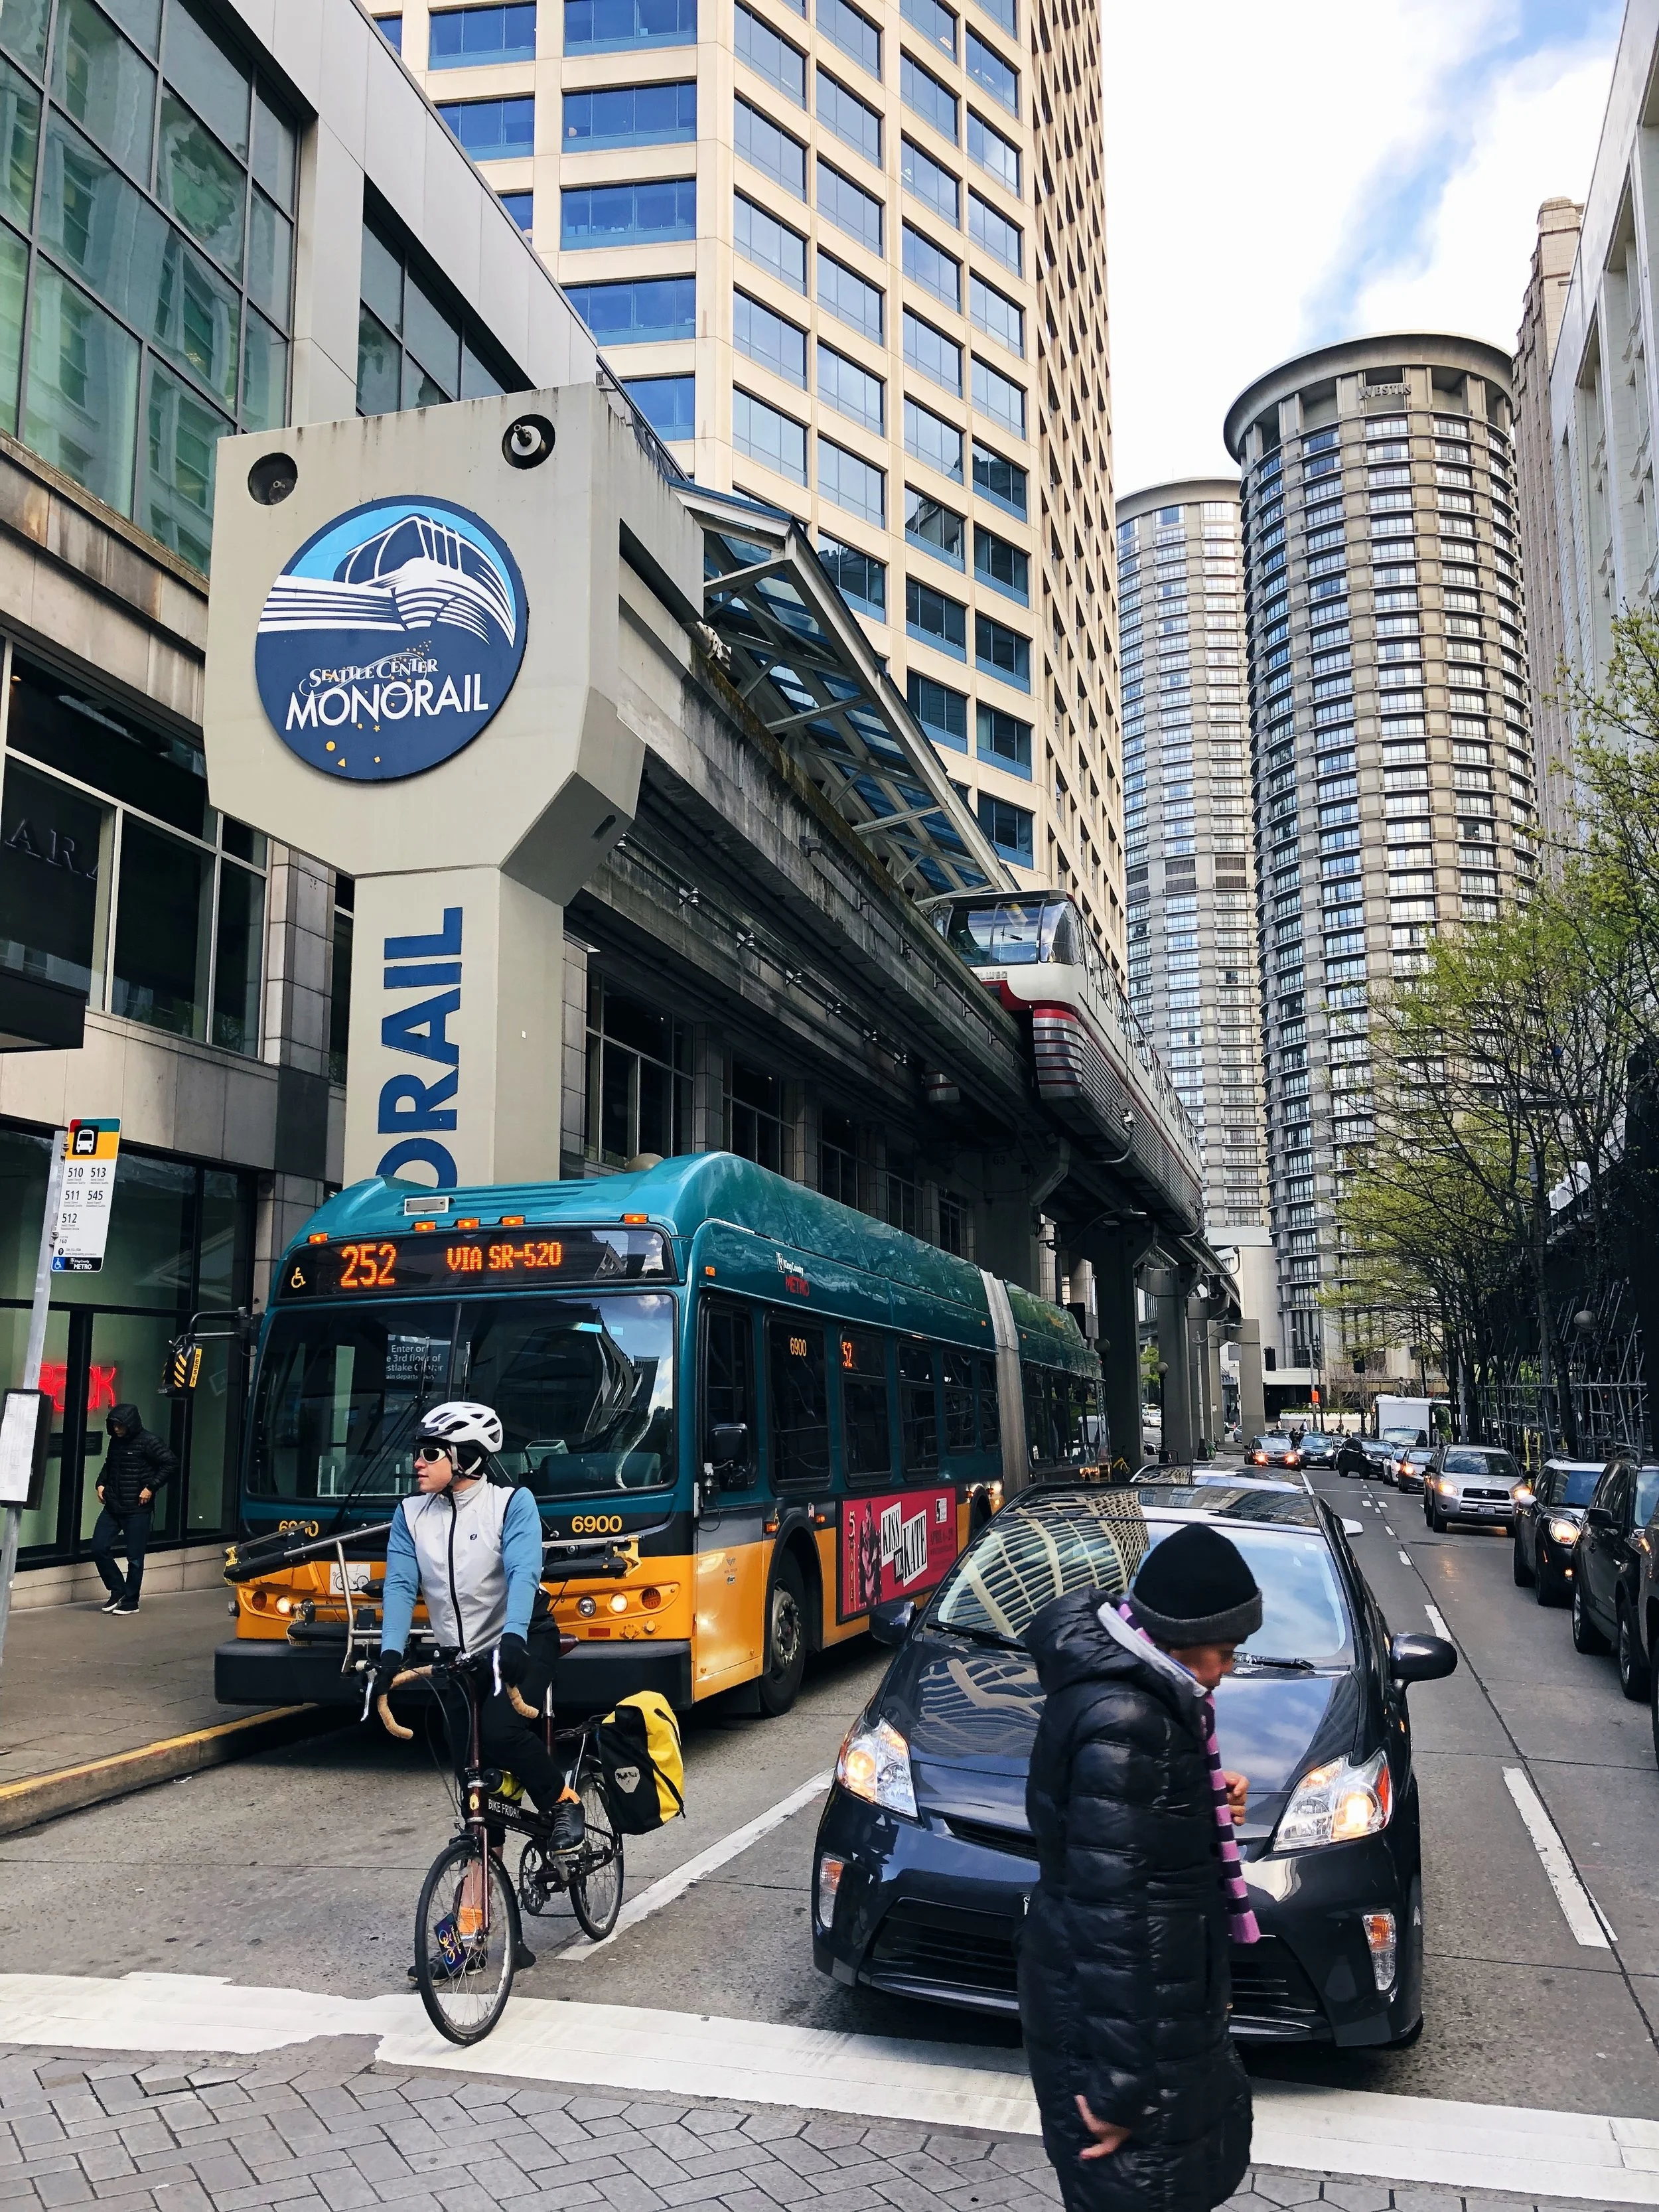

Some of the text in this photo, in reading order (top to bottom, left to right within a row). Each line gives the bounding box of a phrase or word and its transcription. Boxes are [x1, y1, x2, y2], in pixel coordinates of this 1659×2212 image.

[1358, 384, 1412, 399] WESTIN
[309, 658, 439, 688] SEATTLE CENTER
[285, 674, 490, 731] MONORAIL
[68, 1167, 84, 1177] 510
[90, 1167, 106, 1177] 513
[65, 1191, 80, 1200] 511
[88, 1191, 104, 1200] 545
[62, 1213, 78, 1223] 512
[340, 1242, 562, 1287] 252 VIA SR-520
[785, 1276, 810, 1297] METRO
[790, 1337, 807, 1357] 6900
[572, 1515, 622, 1533] 6900
[883, 1509, 900, 1557] KISS
[903, 1514, 926, 1580] KATE
[488, 1799, 520, 1818] BIKE FRIDAY
